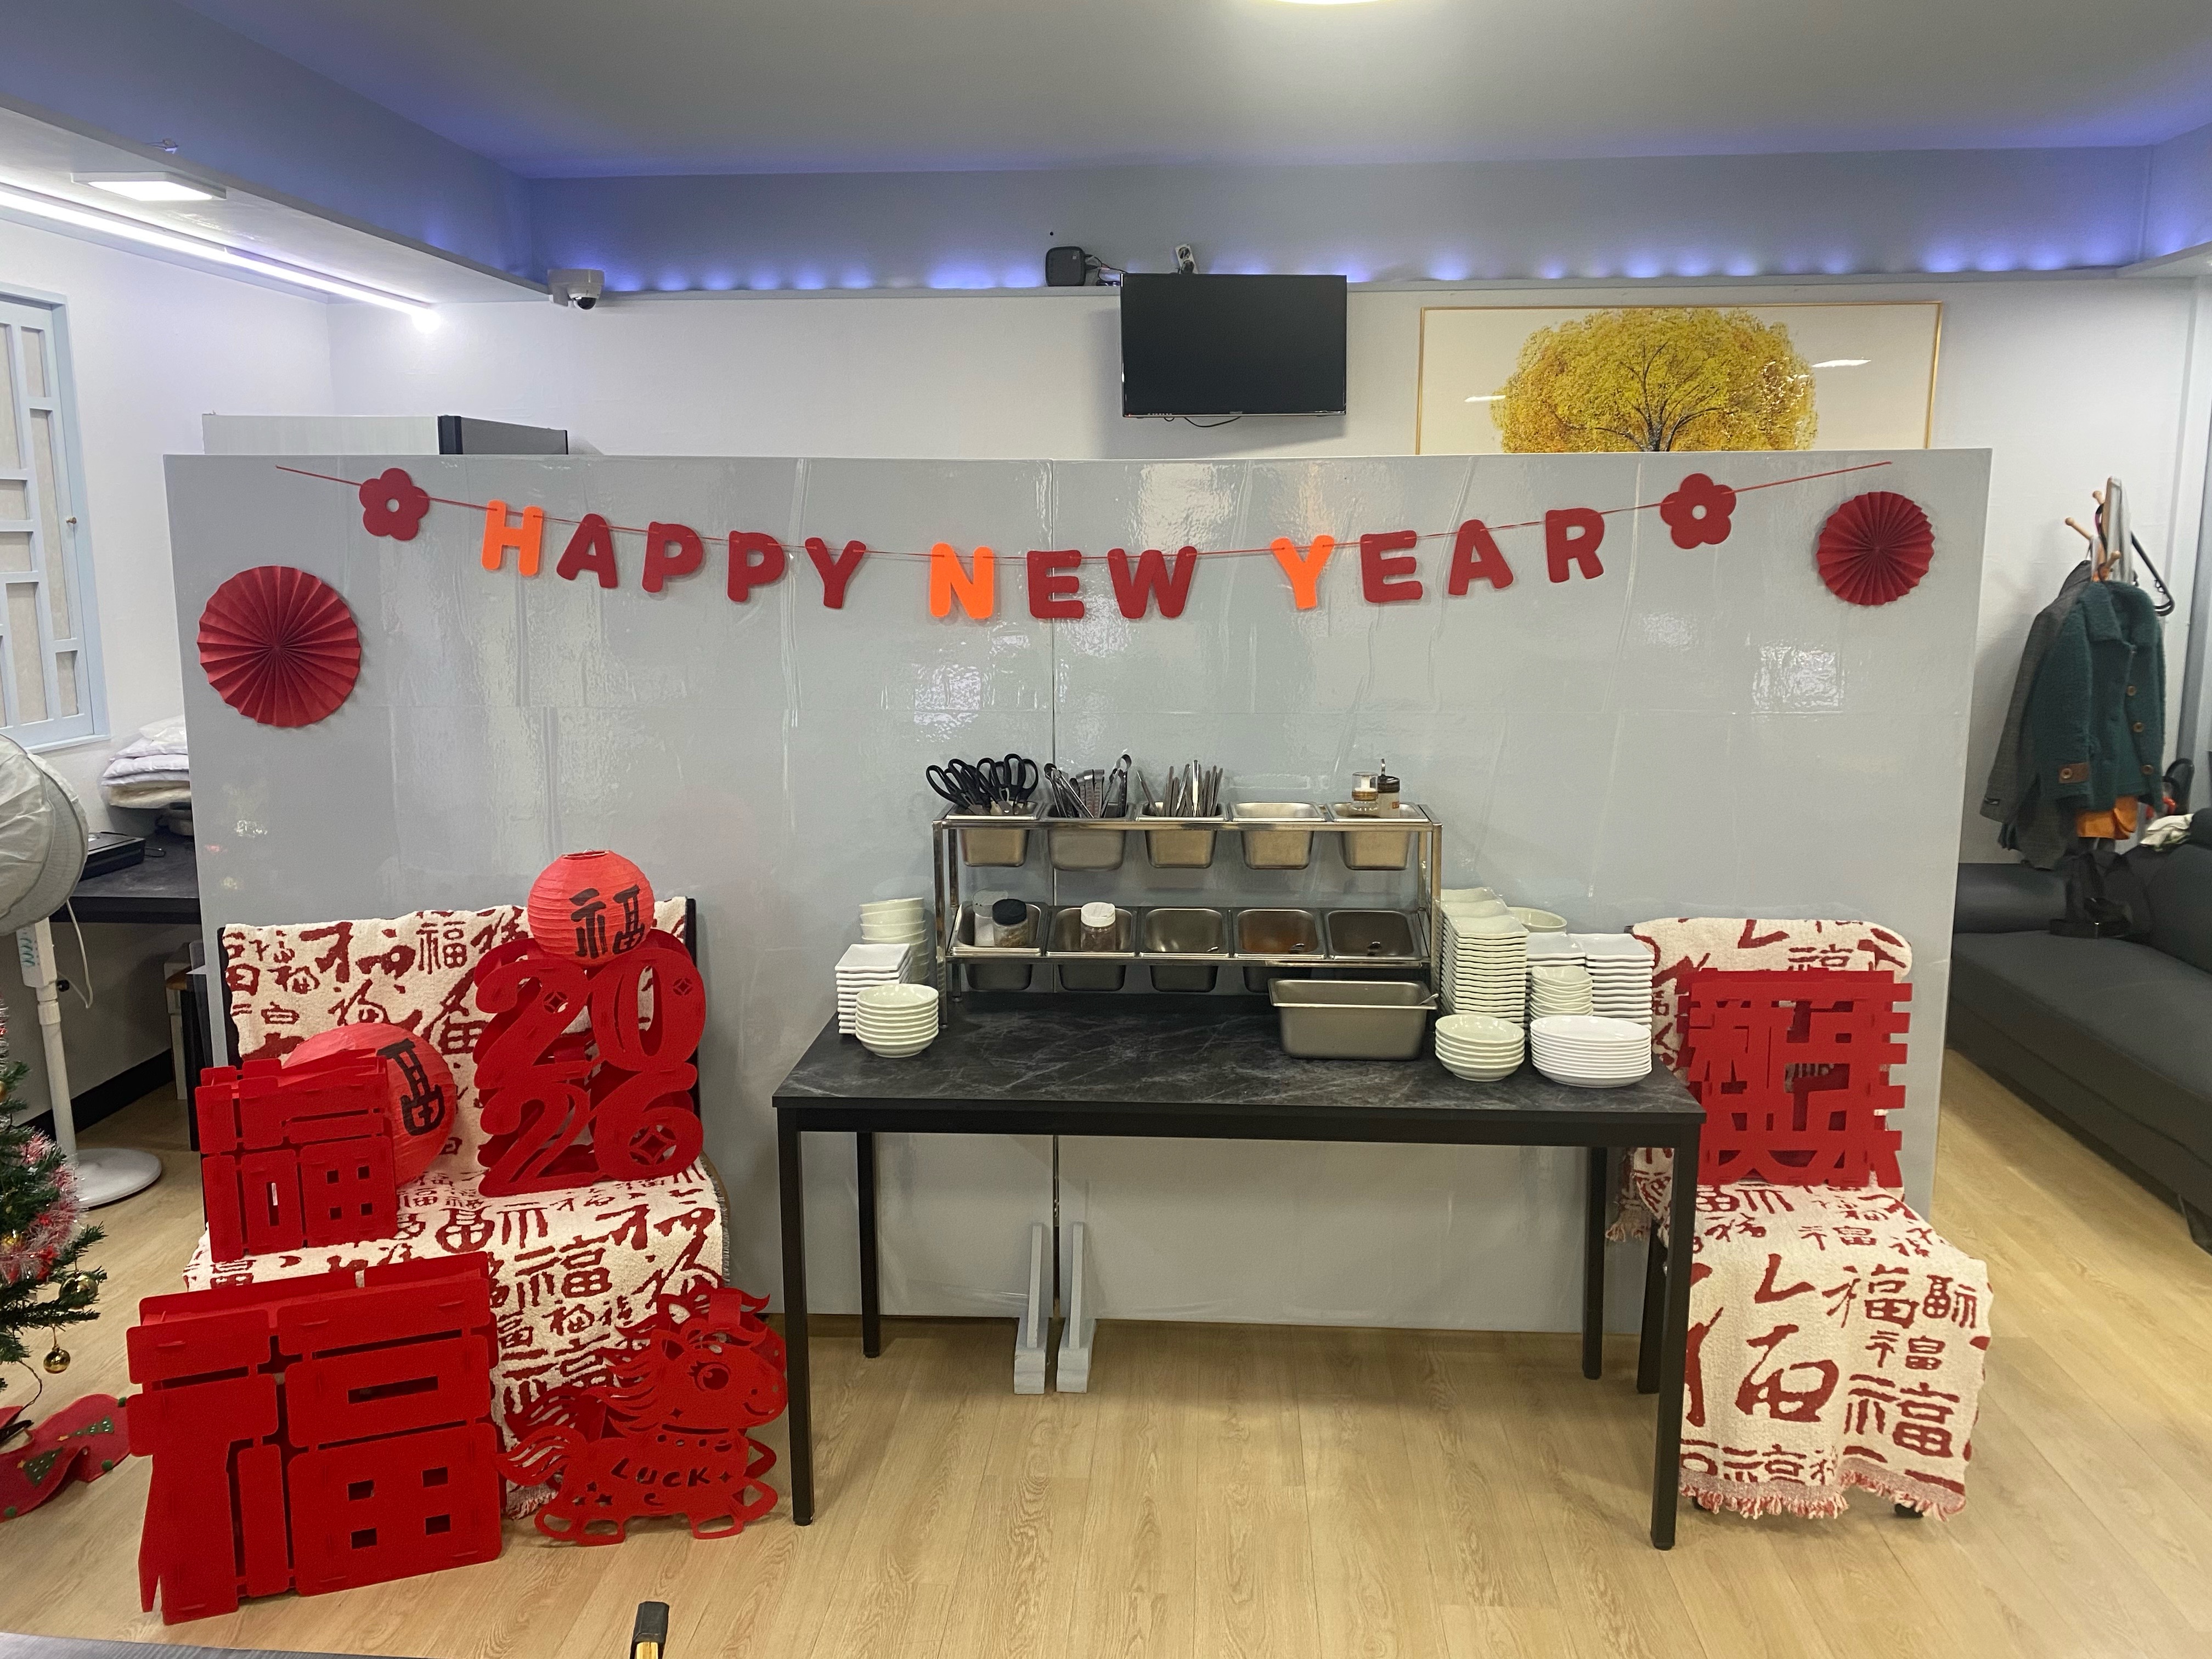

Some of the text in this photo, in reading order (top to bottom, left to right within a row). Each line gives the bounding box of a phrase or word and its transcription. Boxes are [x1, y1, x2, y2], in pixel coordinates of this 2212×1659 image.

[481, 500, 1605, 619] HAPPY NEW YEAR
[416, 921, 467, 975] 福
[568, 884, 646, 960] 福
[515, 1235, 613, 1309] 福
[1822, 1263, 1919, 1328] 福
[543, 1300, 595, 1336] 福
[1865, 1330, 1946, 1370] 福
[125, 1256, 503, 1626] 福
[1842, 1373, 1961, 1458] 福
[610, 1457, 712, 1488] LUCK
